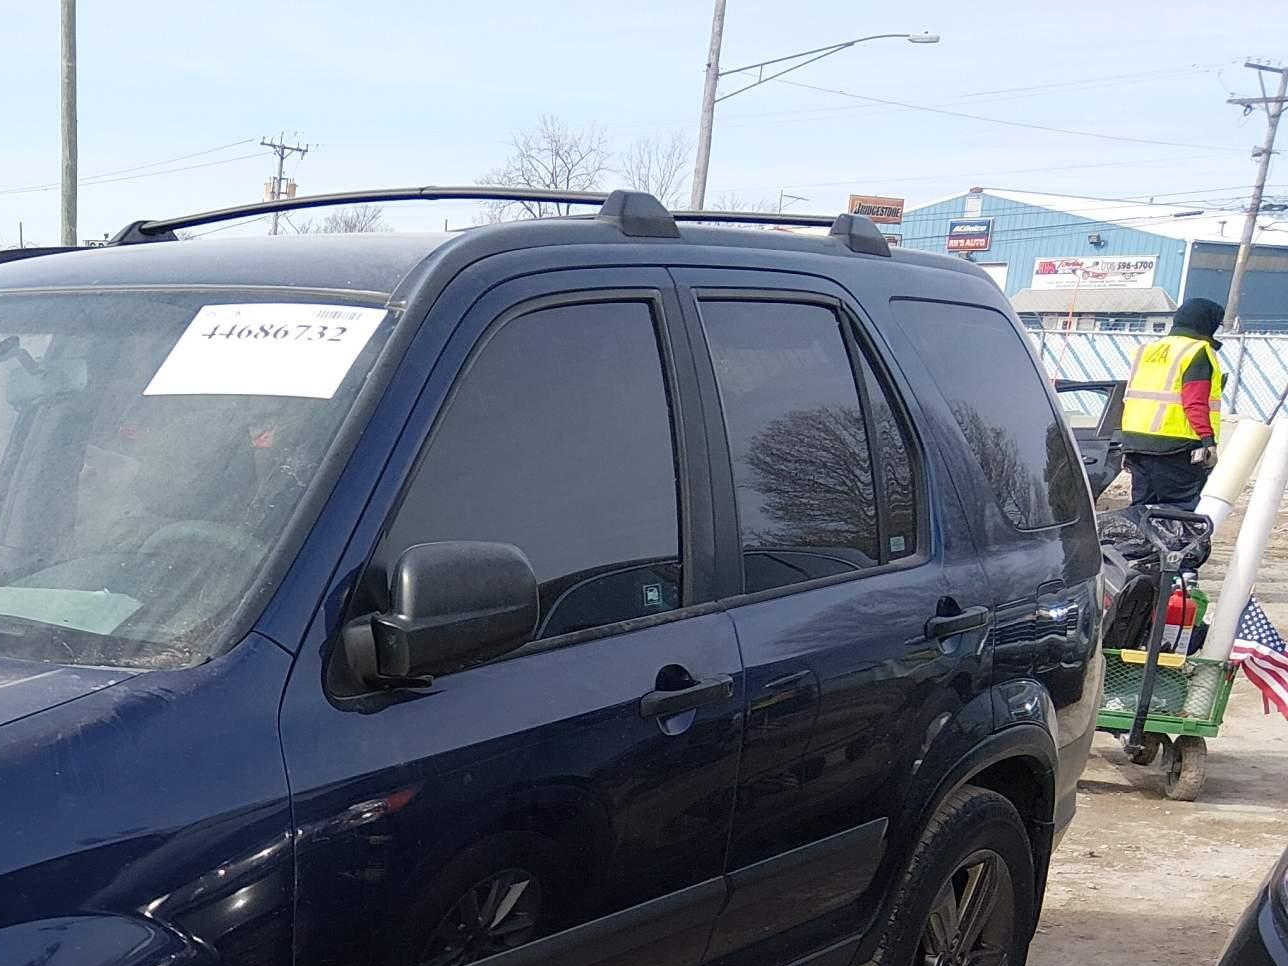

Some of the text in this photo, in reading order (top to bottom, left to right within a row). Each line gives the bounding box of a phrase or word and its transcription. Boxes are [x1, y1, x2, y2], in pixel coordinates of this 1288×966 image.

[854, 202, 902, 217] BRIDGESTONE
[965, 238, 986, 247] AUTO
[1117, 260, 1154, 270] 596-5700
[200, 323, 348, 342] 44686732
